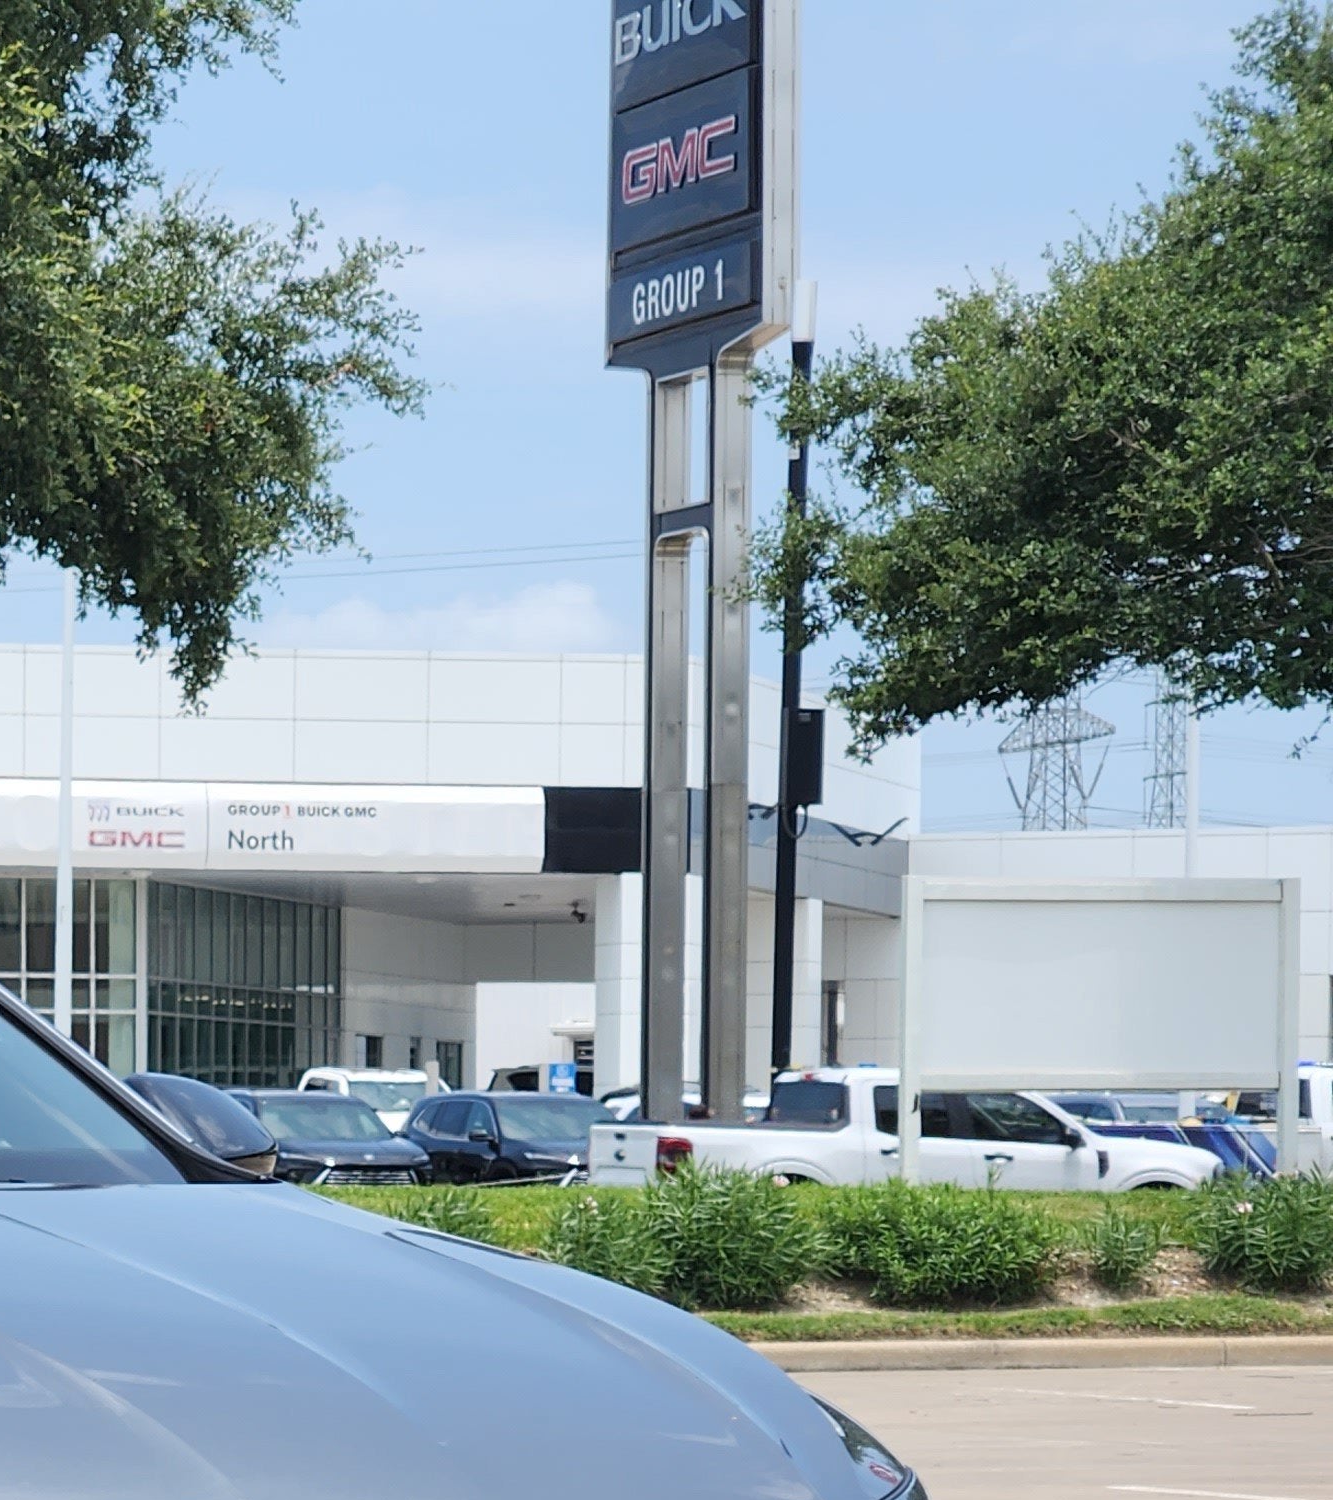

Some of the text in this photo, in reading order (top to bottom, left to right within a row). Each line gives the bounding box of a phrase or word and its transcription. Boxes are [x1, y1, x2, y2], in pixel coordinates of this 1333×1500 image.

[621, 114, 737, 205] GMC
[632, 258, 725, 326] GROUP 1
[116, 805, 186, 817] BUICK
[227, 803, 378, 819] GROUP 1 BUICK GMC
[88, 829, 186, 848] GMC
[227, 829, 295, 851] North
